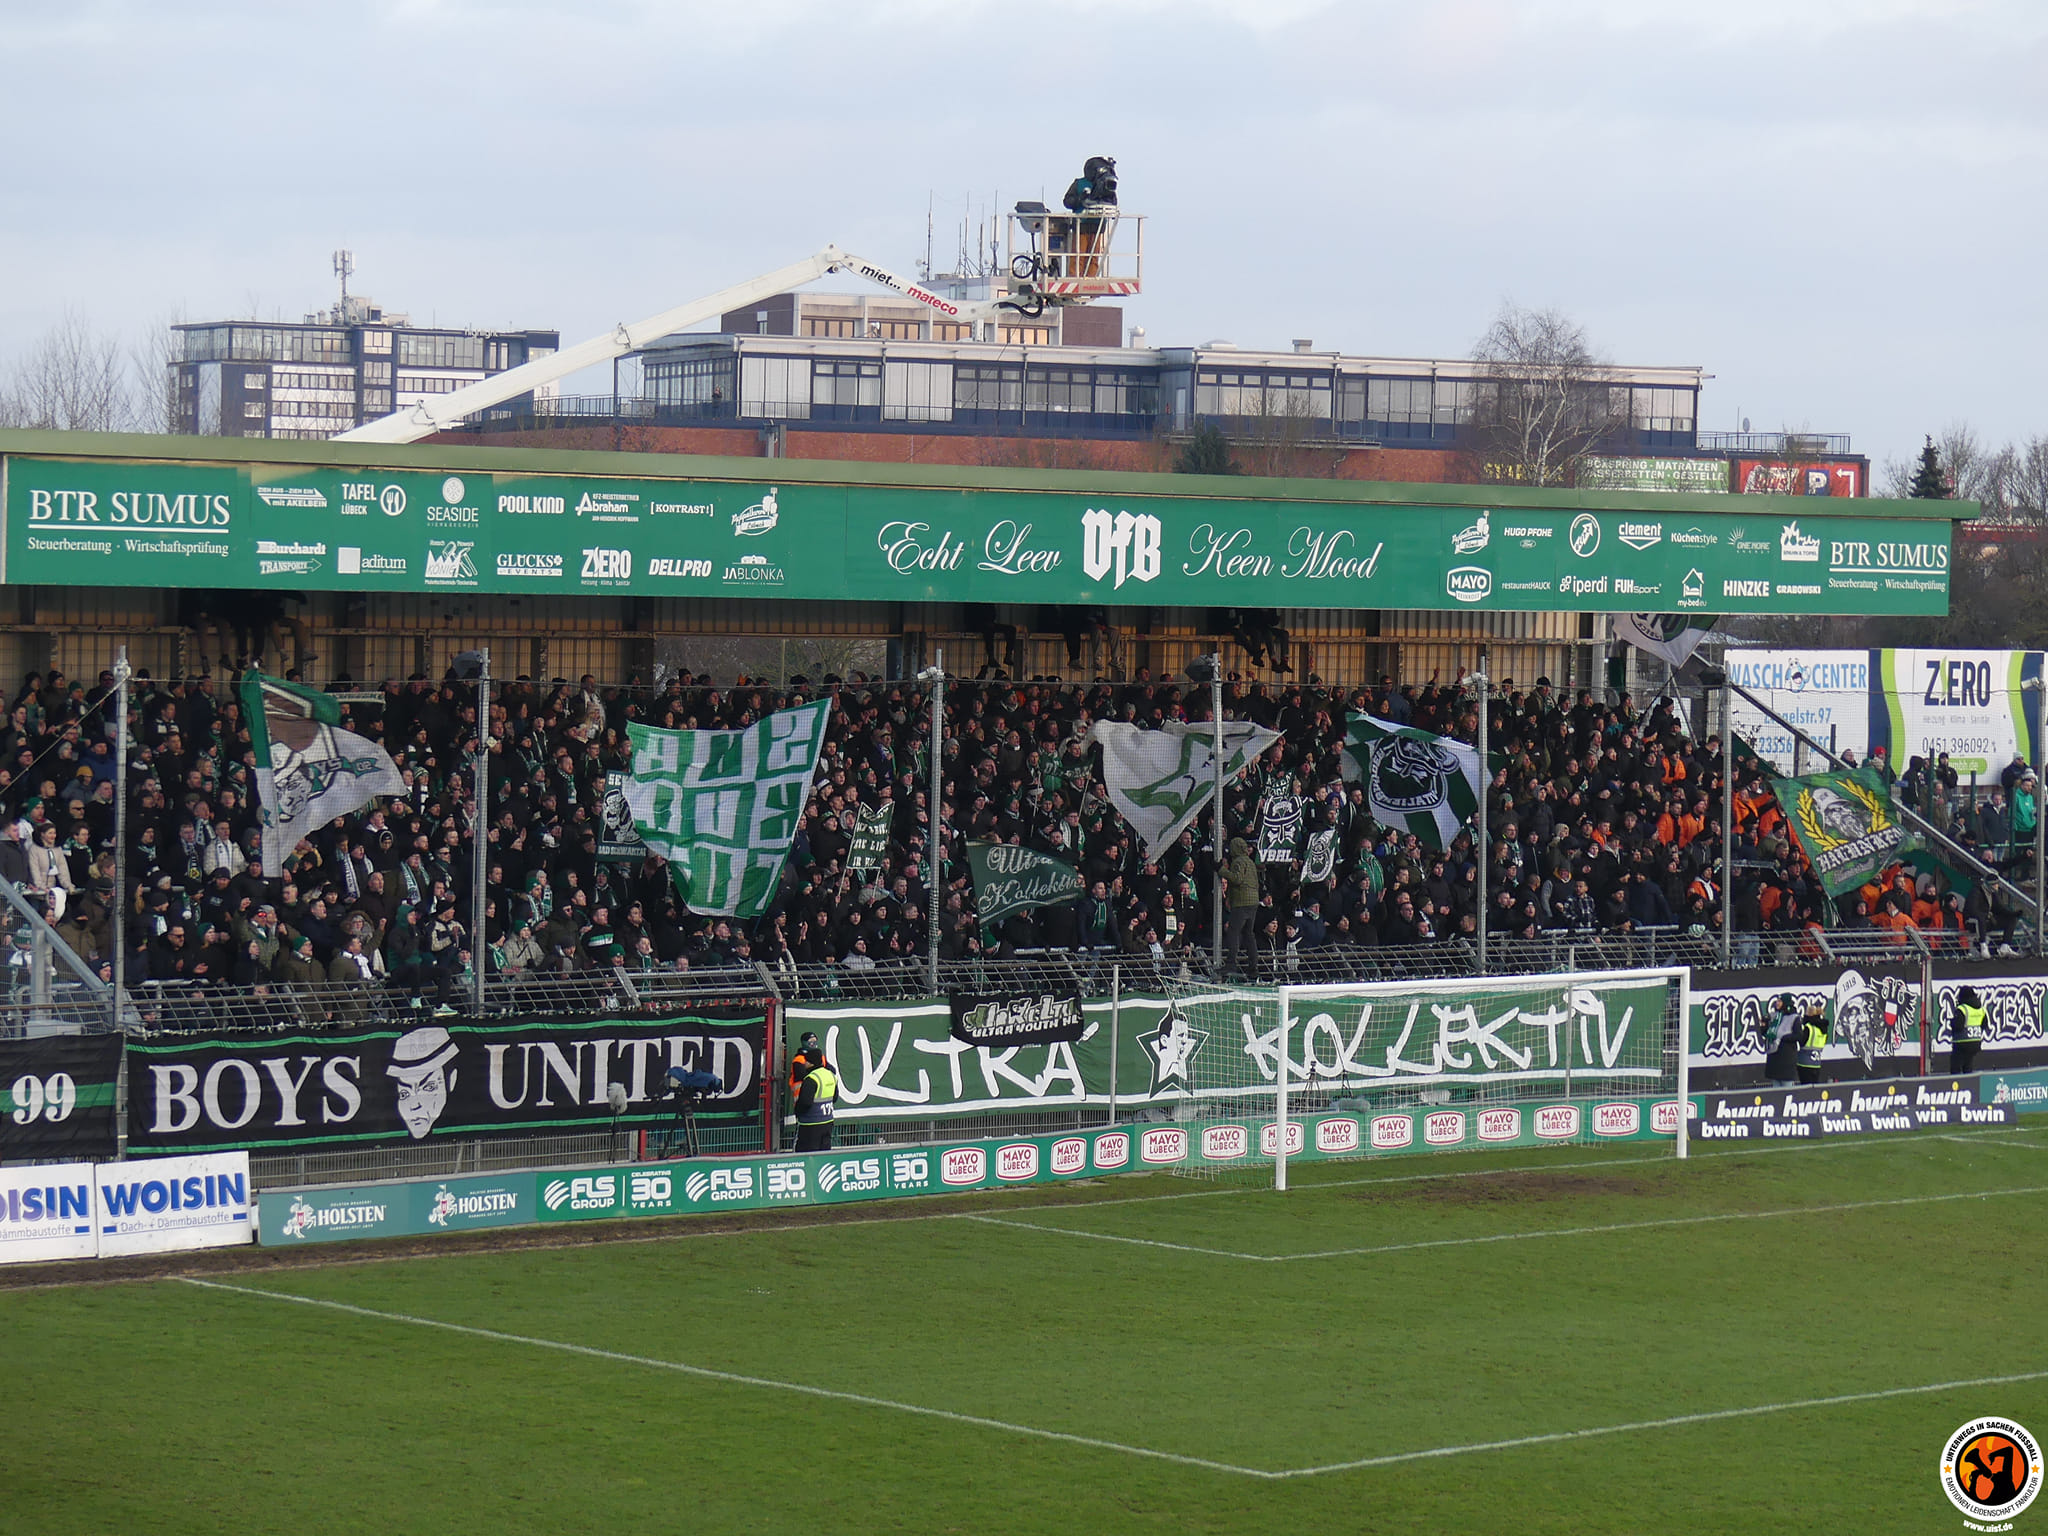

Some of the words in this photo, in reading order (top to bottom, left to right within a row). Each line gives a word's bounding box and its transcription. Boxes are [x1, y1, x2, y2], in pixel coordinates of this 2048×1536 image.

[861, 263, 902, 290] miet...
[907, 286, 958, 316] mateco
[1655, 461, 1718, 472] MATRATZEN
[1673, 470, 1724, 481] GESTELLE
[342, 483, 377, 501] TAFEL
[29, 489, 100, 522] BTR
[110, 491, 231, 525] SUMUS
[341, 503, 368, 515] LÜBECK
[498, 495, 565, 514] POOLKIND
[575, 492, 629, 516] Abraham
[427, 506, 479, 522] SEASIDE
[1504, 527, 1527, 537] HUGO
[1527, 528, 1553, 538] PFOHE
[1618, 522, 1662, 536] clement
[1671, 533, 1718, 545] Küchenstyle
[28, 536, 112, 554] Steuerberatung
[124, 539, 229, 557] Wirtschaftsprüfung
[268, 541, 327, 555] Burchardt
[877, 520, 965, 576] Echt
[976, 519, 1062, 576] Leev
[1081, 508, 1163, 591] VfB
[1182, 523, 1275, 579] Keen
[1281, 526, 1384, 580] Mood
[362, 554, 407, 569] aditum
[497, 554, 554, 568] GLÜCKS
[1830, 541, 1871, 566] BTR
[1876, 543, 1948, 568] SUMUS
[581, 549, 632, 578] ZERO
[649, 559, 712, 578] DELLPRO
[722, 567, 785, 581] JABLONKA
[1451, 575, 1487, 589] MAYO
[1573, 576, 1608, 597] iperdi
[1723, 580, 1770, 597] HINZKE
[1829, 577, 1878, 591] Steuerberatung
[1885, 578, 1946, 593] Wirtschaftsprüfung
[1776, 585, 1821, 594] GRABOWSKI
[1729, 664, 1783, 689] WASCH
[1812, 664, 1868, 688] CENTER
[1924, 660, 1991, 707] ZERO
[1758, 737, 1793, 753] 23556
[1922, 737, 1947, 753] 0451
[1950, 737, 1989, 753] 396092
[986, 845, 1055, 875] Ultra
[1259, 849, 1293, 862] VBHL
[971, 1023, 1014, 1038] ULTRA
[1016, 1018, 1060, 1033] YOUTH
[1063, 1014, 1079, 1026] HL
[1242, 990, 1633, 1081] KOLLEKTIV
[826, 1021, 1099, 1105] ULTRA
[149, 1055, 362, 1133] BOYS
[484, 1035, 753, 1109] UNITED
[12, 1072, 77, 1125] 99
[2011, 1086, 2048, 1101] HOLSTEN
[1484, 1113, 1514, 1124] MAYO
[1541, 1110, 1572, 1121] MAYO
[1600, 1108, 1632, 1119] MAYO
[1915, 1106, 1948, 1123] win
[1960, 1104, 2005, 1122] bwin
[1378, 1119, 1406, 1130] MAYO
[1431, 1116, 1458, 1127] MAYO
[1541, 1120, 1571, 1130] LÜBECK
[1600, 1118, 1632, 1127] LÜBECK
[1658, 1116, 1678, 1125] LÜBE
[1763, 1119, 1810, 1136] bwin
[1822, 1114, 1862, 1132] bwin
[1871, 1112, 1911, 1130] bwin
[1268, 1128, 1297, 1139] MYO
[1323, 1124, 1351, 1134] MAYO
[1378, 1129, 1405, 1140] LÜBECK
[1431, 1126, 1457, 1137] LÜBECK
[1484, 1123, 1513, 1133] LÜBECK
[1701, 1121, 1748, 1137] bwin
[1149, 1133, 1180, 1145] MAYO
[1209, 1130, 1240, 1141] MAYO
[1268, 1137, 1297, 1147] LÜCK
[1323, 1134, 1351, 1144] LÜBECK
[1057, 1143, 1080, 1155] MAYO
[1100, 1138, 1123, 1150] MAYO
[1149, 1143, 1179, 1154] LÜBECK
[1209, 1140, 1240, 1151] LÜBECK
[892, 1151, 928, 1159] CELEBRATING
[949, 1153, 979, 1165] MAYO
[1003, 1149, 1032, 1161] MAYO
[1056, 1153, 1080, 1165] LÜBECK
[1100, 1148, 1123, 1159] LÜBECK
[767, 1161, 805, 1169] CELEBRATING
[840, 1158, 880, 1181] FLS
[894, 1158, 928, 1181] 30
[950, 1164, 978, 1175] LÜBECK
[1003, 1159, 1031, 1170] LÜBECK
[631, 1170, 671, 1178] CELEBRATING
[710, 1168, 752, 1190] FLS
[768, 1169, 805, 1192] 30
[571, 1176, 615, 1199] FLS
[631, 1177, 671, 1201] 30
[842, 1180, 880, 1192] GROUP
[894, 1180, 929, 1190] YEARS
[101, 1172, 246, 1219] WOISIN
[711, 1188, 753, 1201] GROUP
[768, 1191, 806, 1199] YEARS
[458, 1193, 516, 1213] HOLSTEN
[571, 1198, 615, 1209] GROUP
[632, 1200, 672, 1209] YEARS
[121, 1220, 148, 1232] Dach-
[157, 1212, 230, 1228] Dämmbaustoffe
[318, 1205, 386, 1226] HOLSTEN
[0, 1225, 71, 1239] ämmbaustoffe
